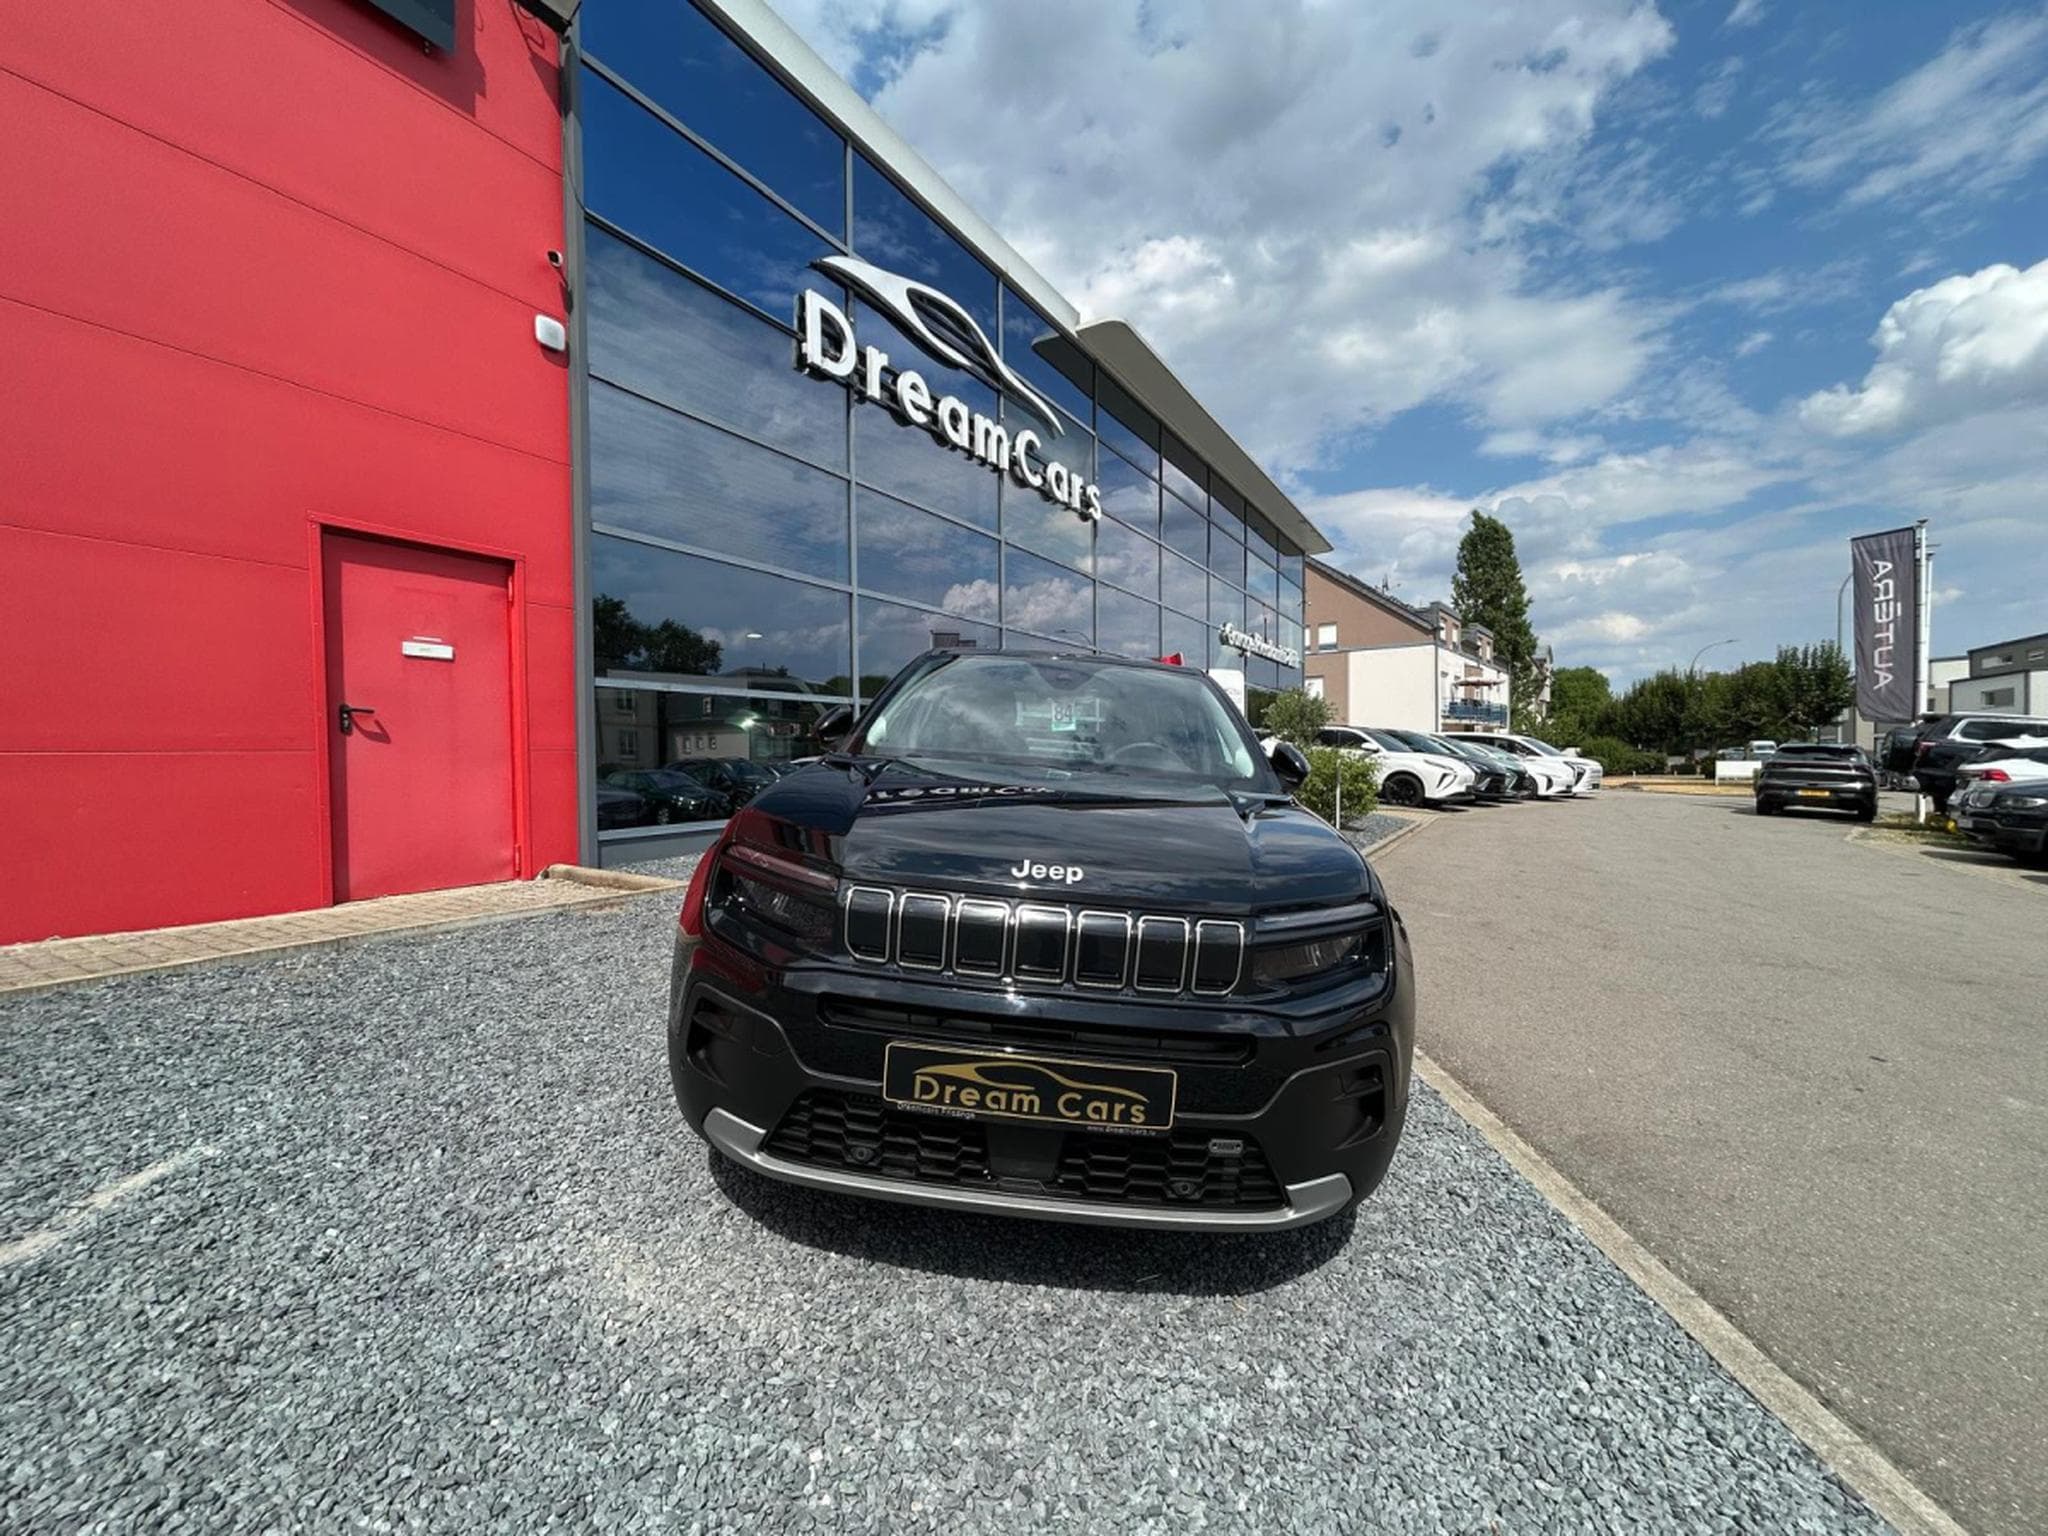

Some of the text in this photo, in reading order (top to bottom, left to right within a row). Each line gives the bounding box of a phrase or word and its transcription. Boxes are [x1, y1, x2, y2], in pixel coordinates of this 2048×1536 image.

[1011, 859, 1084, 885] Jeep
[913, 1075, 1147, 1124] Dream Cars
